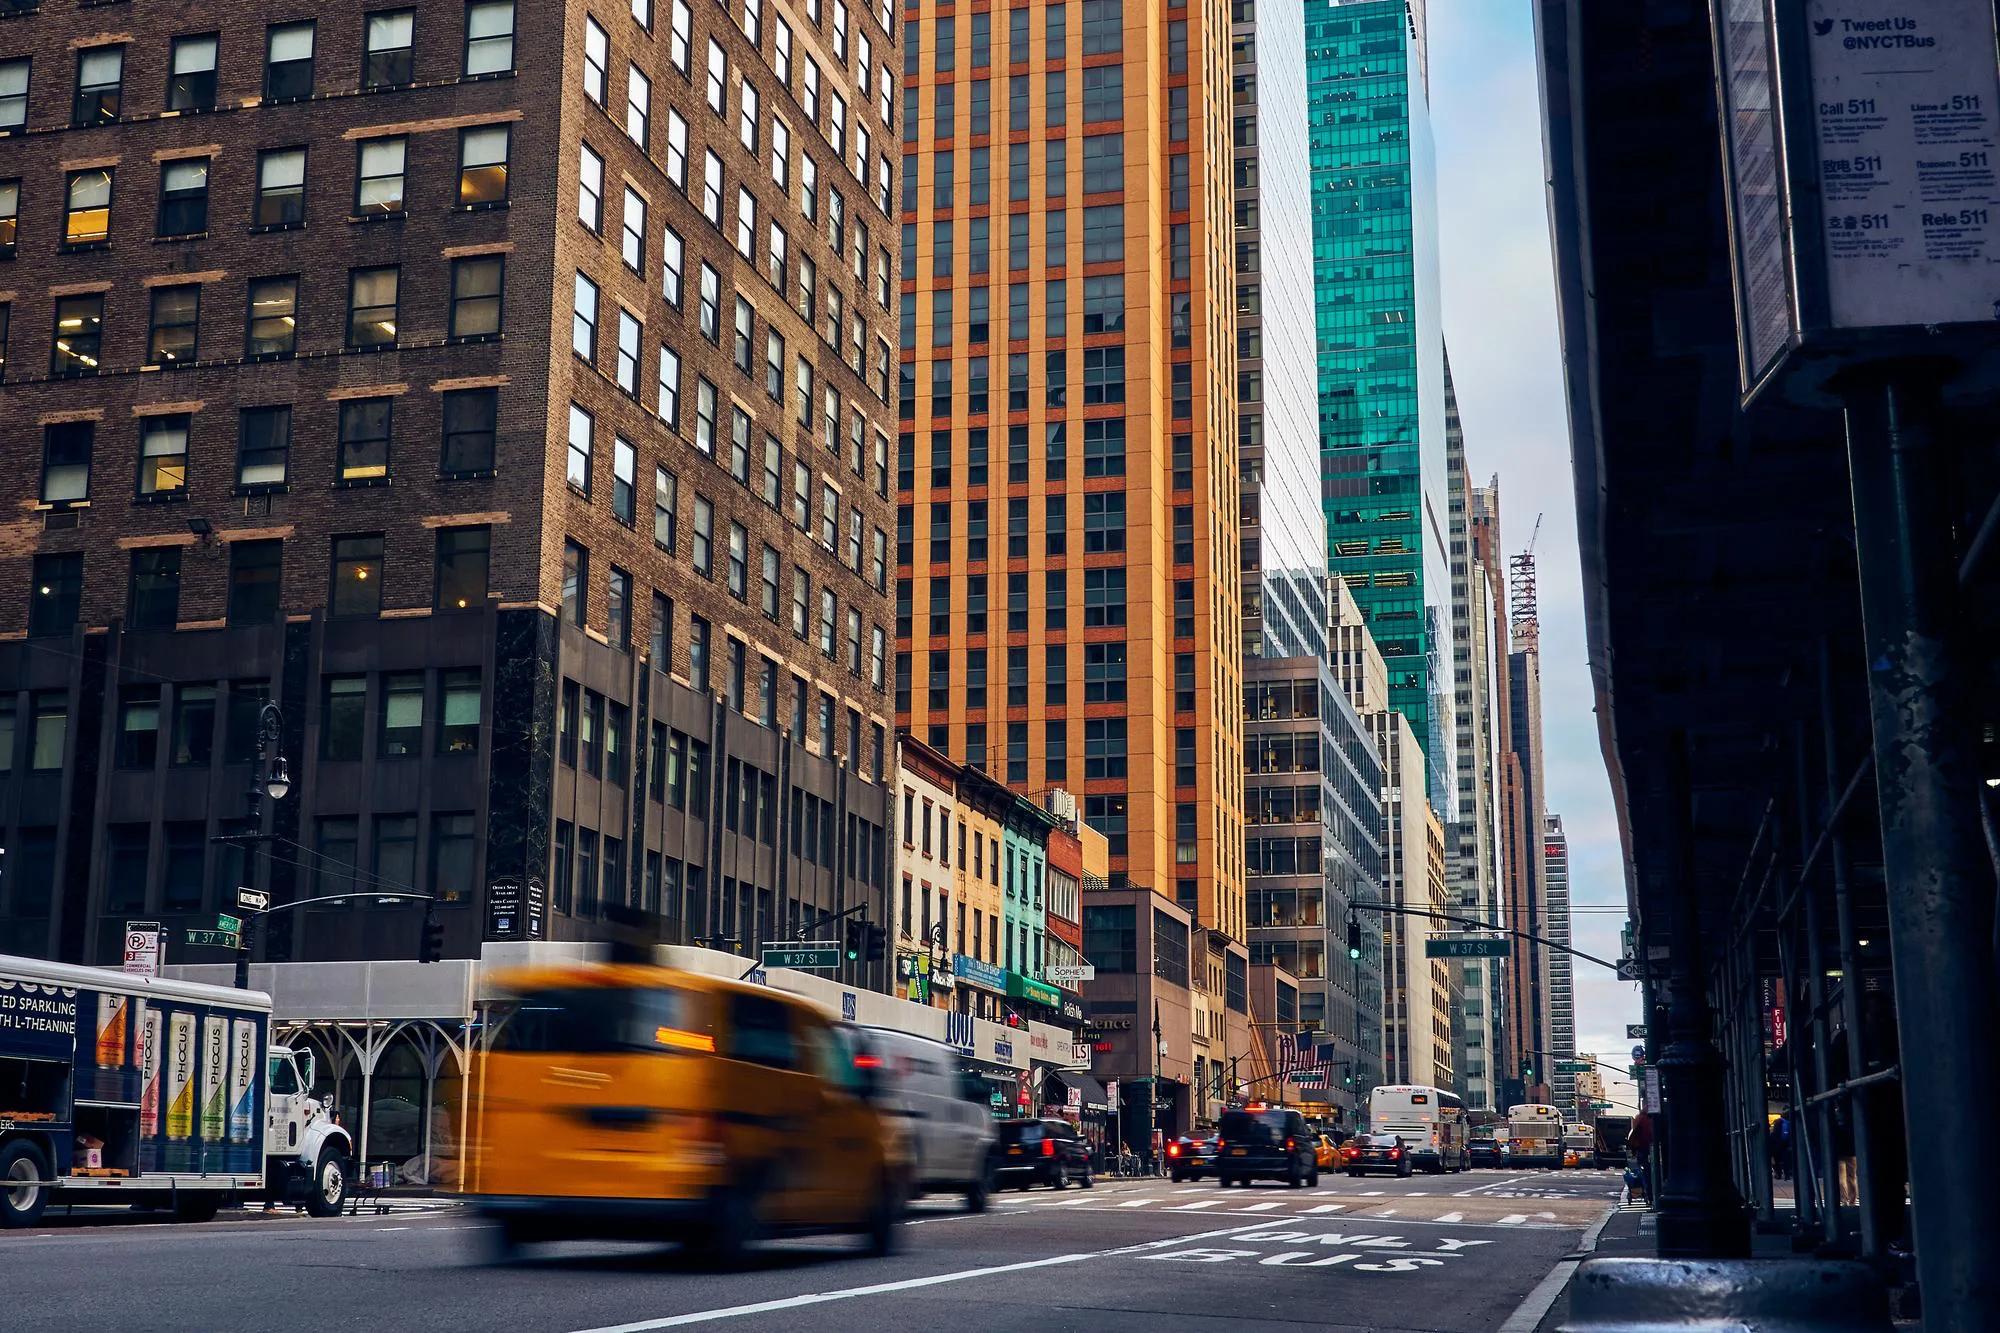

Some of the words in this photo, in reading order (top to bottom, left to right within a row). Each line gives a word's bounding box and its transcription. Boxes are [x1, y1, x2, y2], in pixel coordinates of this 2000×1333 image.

[1841, 18, 1891, 31] Tweet
[1894, 17, 1916, 30] Us
[1843, 34, 1936, 49] @NYCTBus
[1820, 102, 1844, 115] Call
[1848, 98, 1875, 114] 511
[1952, 95, 1979, 110] 511
[1854, 156, 1881, 171] 511
[1959, 151, 1987, 167] 511
[1861, 214, 1888, 229] 511
[1922, 212, 1957, 226] Rele
[1960, 209, 1987, 225] 511
[188, 931, 196, 943] W
[202, 932, 215, 943] 37
[224, 934, 230, 945] 6
[1449, 943, 1457, 954] W
[1461, 943, 1472, 954] 37
[1477, 943, 1488, 954] St
[783, 954, 791, 964] W
[794, 954, 805, 964] 37
[808, 953, 818, 964] St
[1055, 967, 1086, 976] SOPHIE'S
[1626, 965, 1645, 974] ONE
[19, 997, 76, 1016] SPARKLING
[15, 1015, 75, 1034] L-THEANINE
[1774, 1009, 1782, 1036] FIVE
[1633, 1028, 1647, 1036] ONE
[144, 1021, 153, 1080] PHOCUS
[178, 1025, 187, 1083] PHOCUS
[211, 1028, 221, 1085] PHOCUS
[240, 1032, 249, 1087] PHOCUS
[0, 1120, 15, 1130] ERS
[1231, 1231, 1497, 1251] ONLY
[1135, 1248, 1445, 1272] BUS
